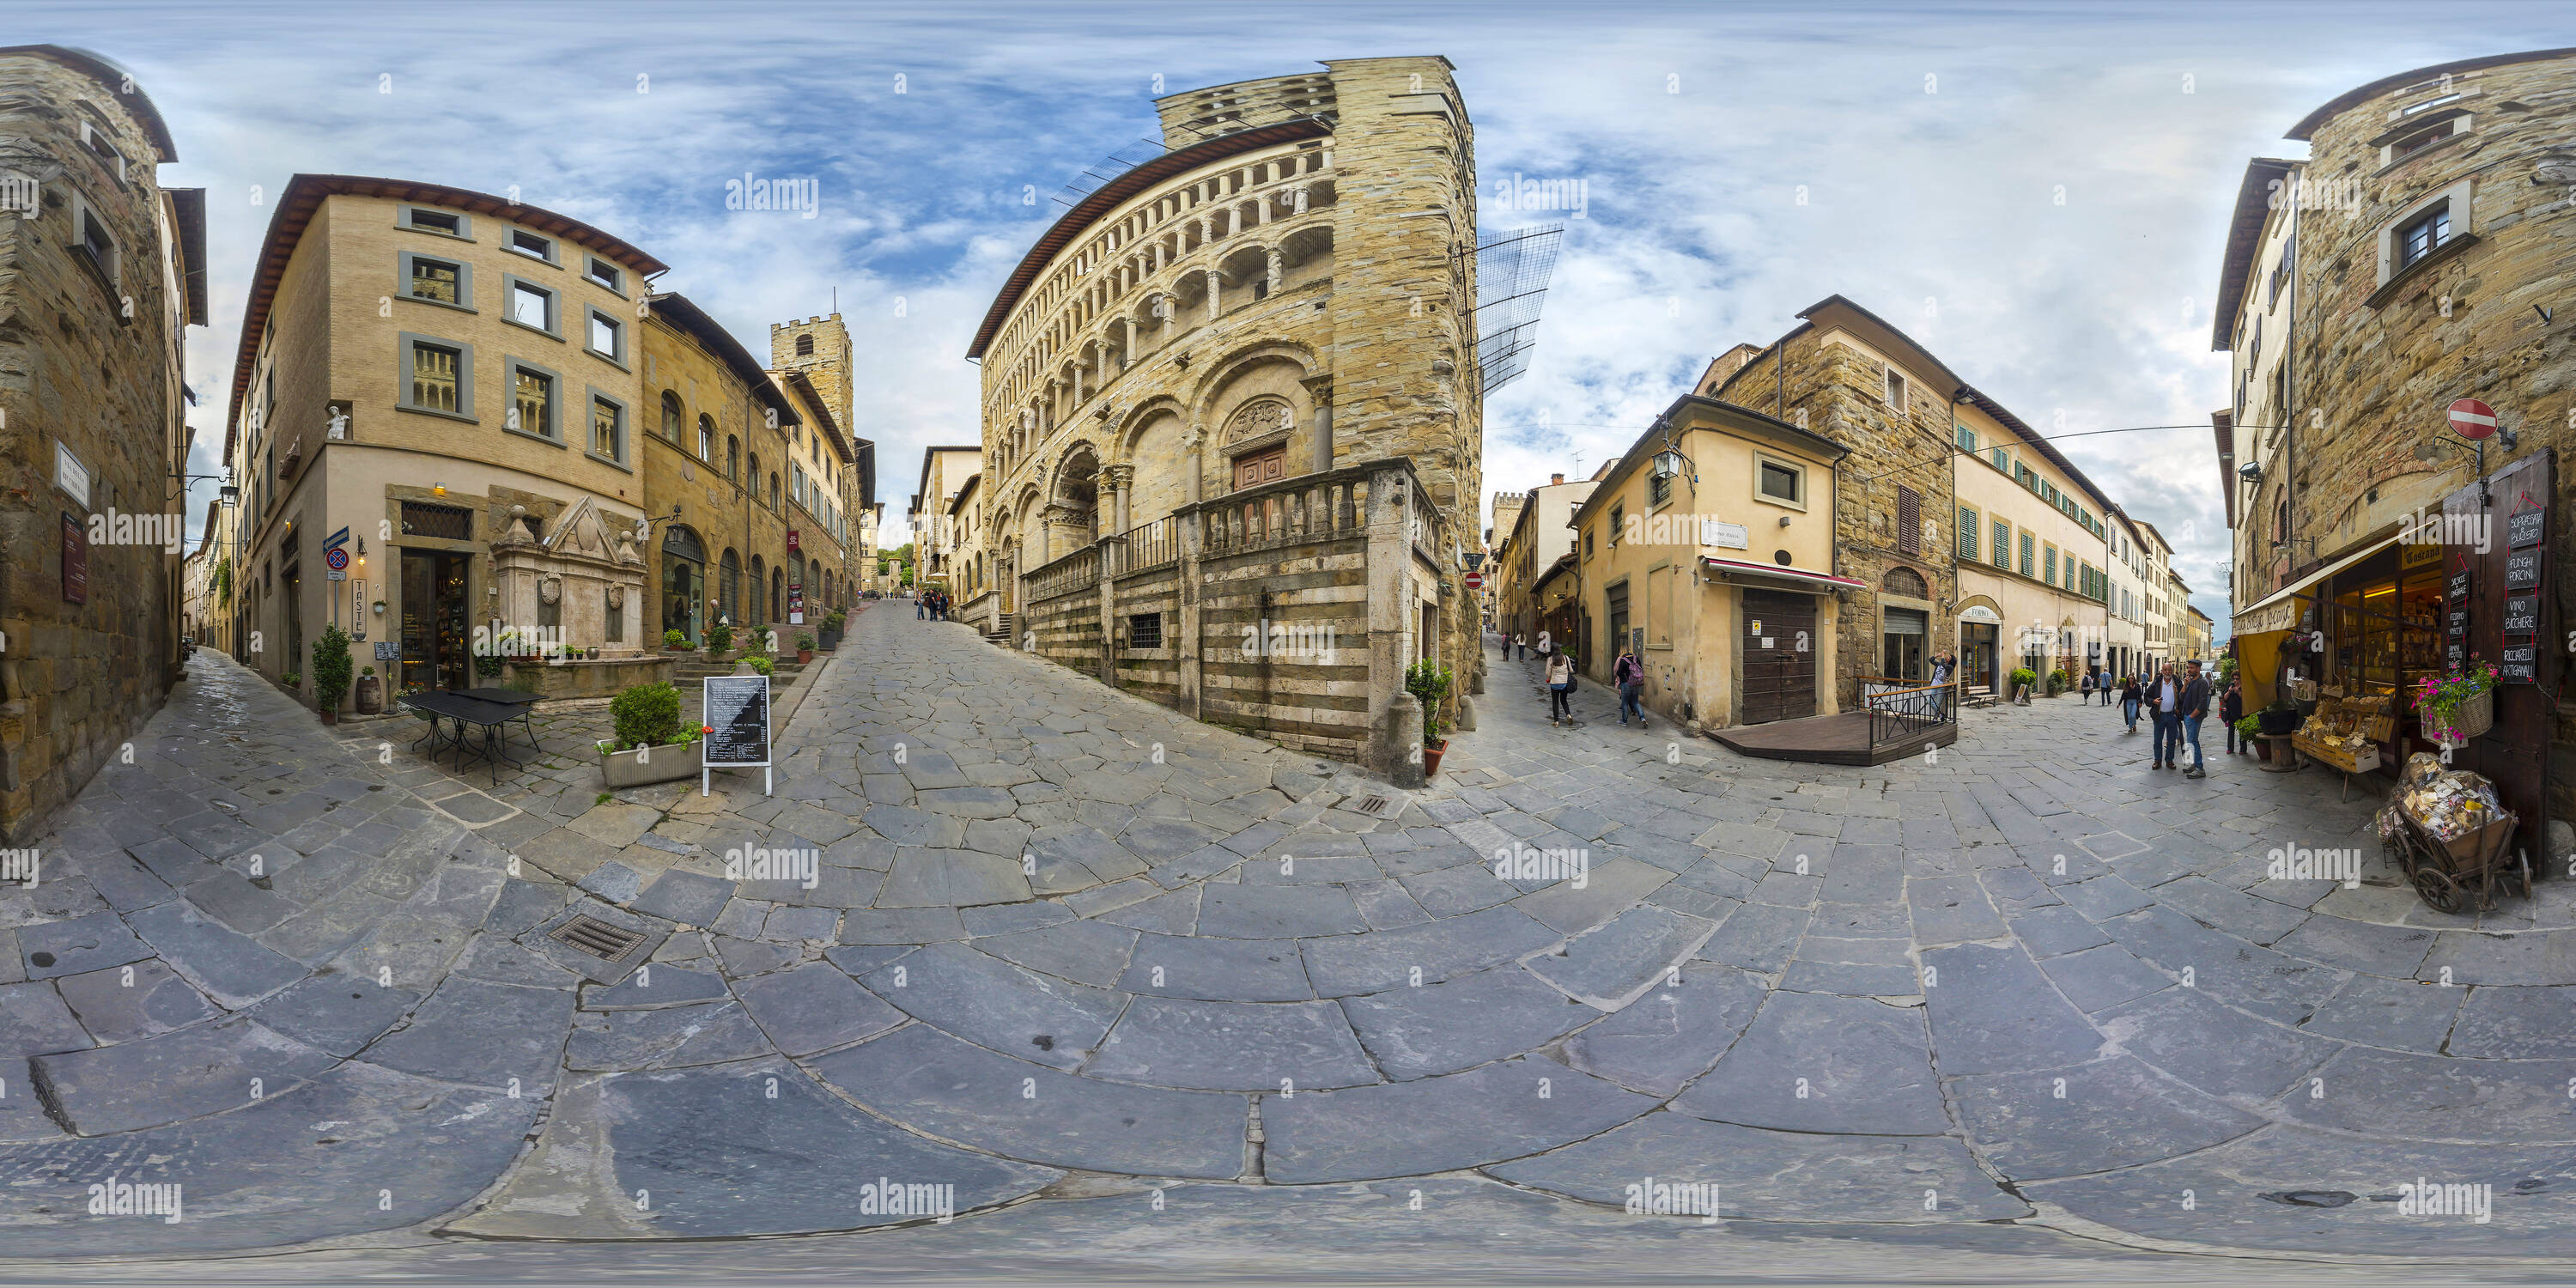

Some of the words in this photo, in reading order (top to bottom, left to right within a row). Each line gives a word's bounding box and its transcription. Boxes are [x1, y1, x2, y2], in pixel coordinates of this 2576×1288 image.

[2404, 547, 2440, 564] Toscana
[2509, 556, 2533, 568] FUNGHI
[2509, 568, 2533, 581] PORCINI
[2509, 600, 2525, 611] VINO
[1971, 608, 1989, 617] FORNO
